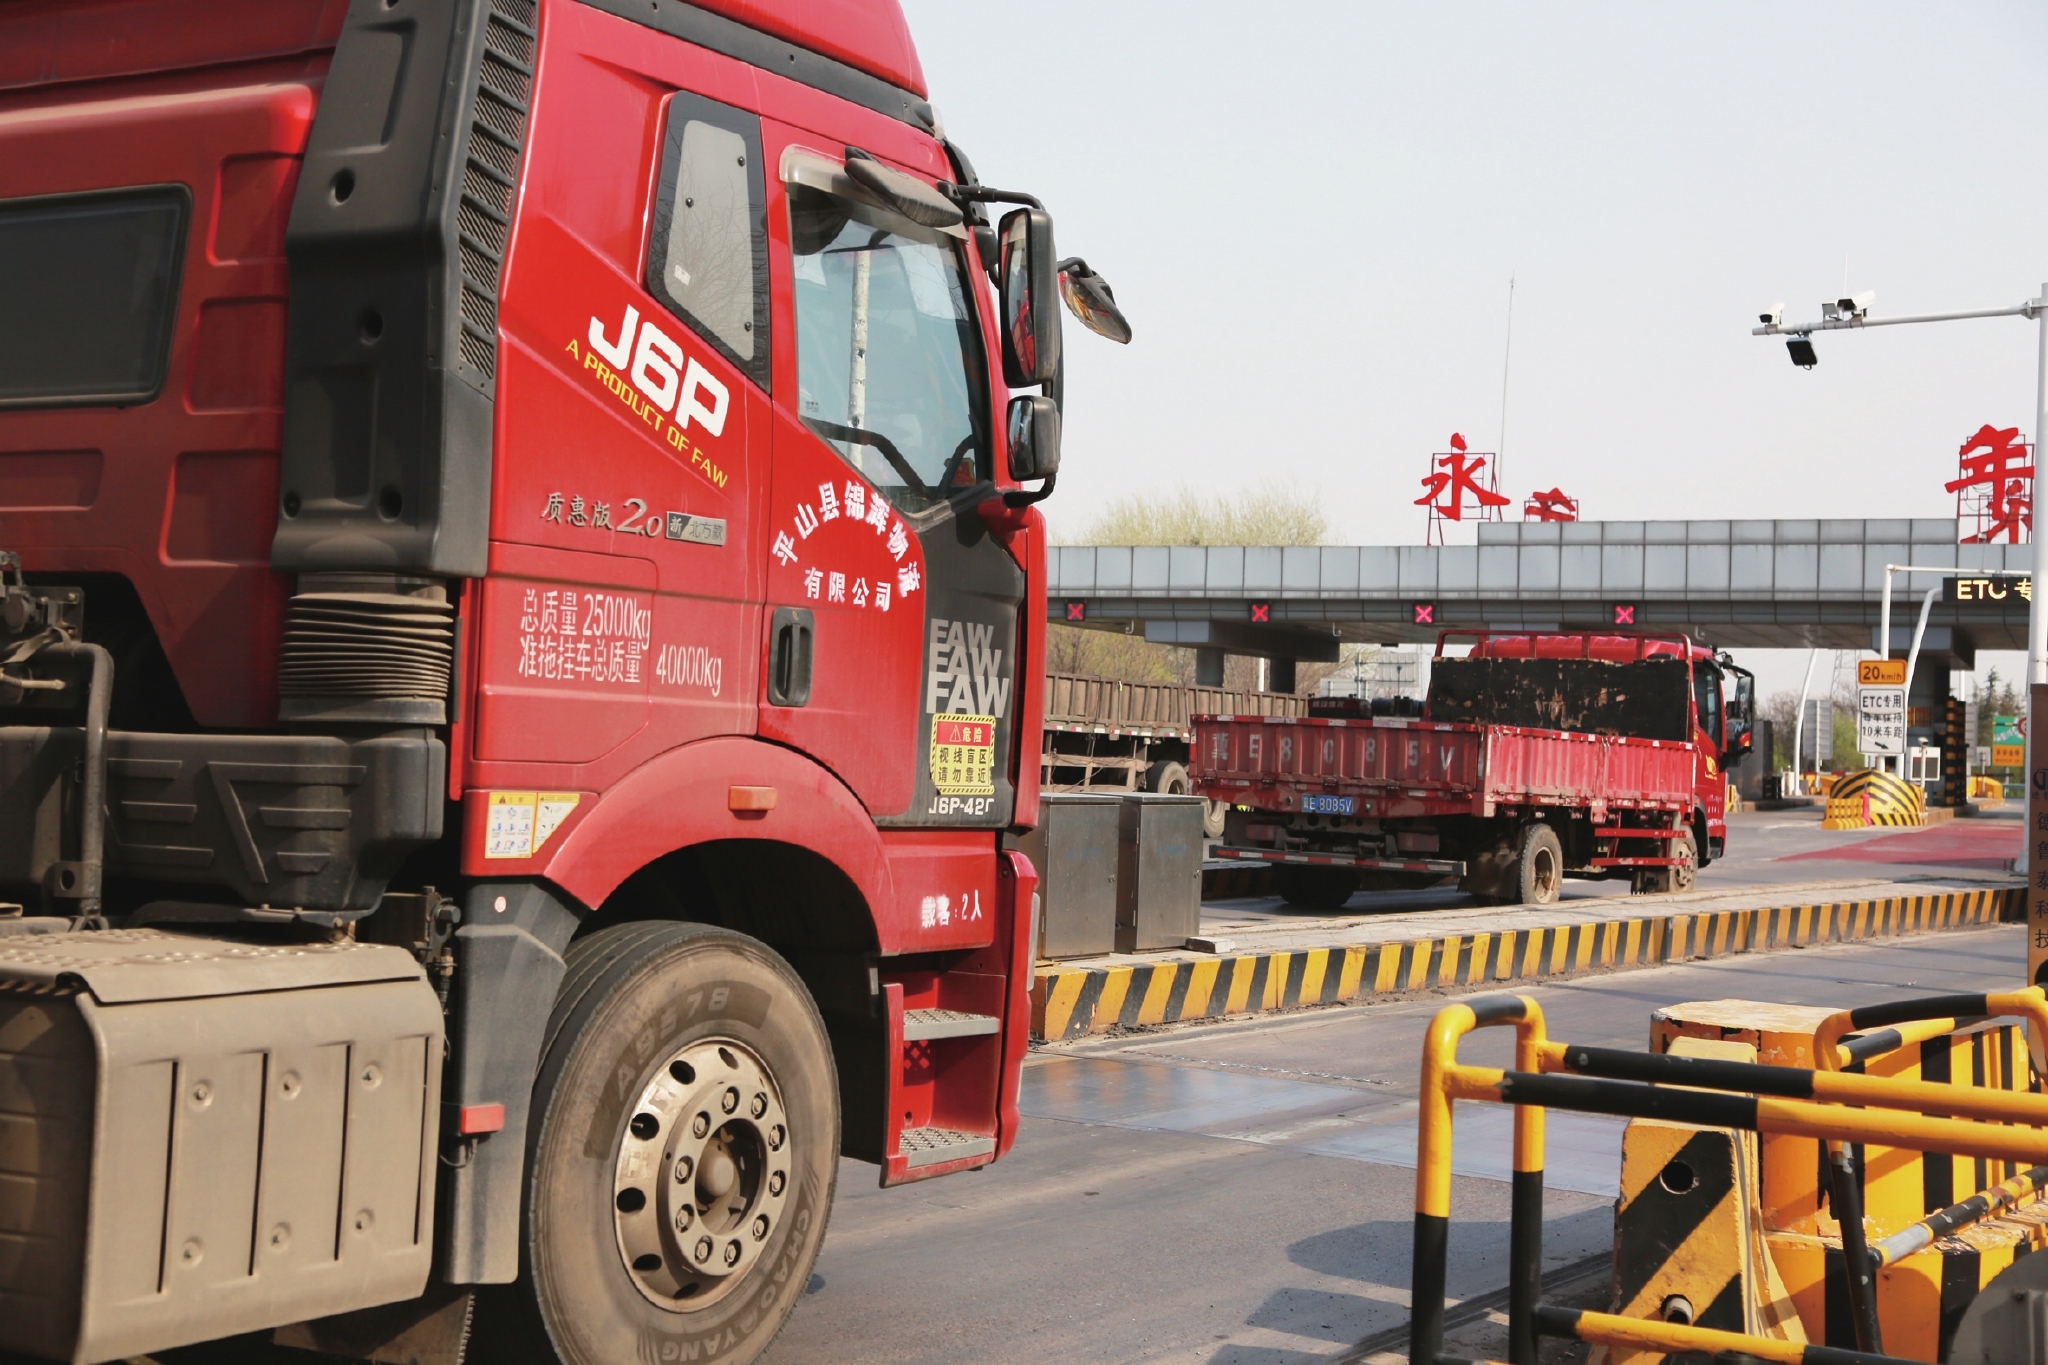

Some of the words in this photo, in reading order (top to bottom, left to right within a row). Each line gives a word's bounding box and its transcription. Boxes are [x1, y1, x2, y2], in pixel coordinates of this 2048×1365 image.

[588, 303, 730, 438] J6P
[565, 338, 579, 361] A
[583, 351, 665, 431] PRODUCT
[666, 425, 690, 451] OF
[691, 446, 728, 489] FAW
[804, 566, 892, 612] 有限公司
[931, 618, 994, 648] FAW
[518, 634, 642, 683] 准拖挂车总质量
[655, 643, 722, 697] 40000kg
[929, 642, 1002, 678] FAW
[926, 671, 1009, 718] FAW
[962, 727, 982, 742] 危险
[938, 767, 986, 783] 请勿靠近
[939, 749, 987, 764] 视线盲区
